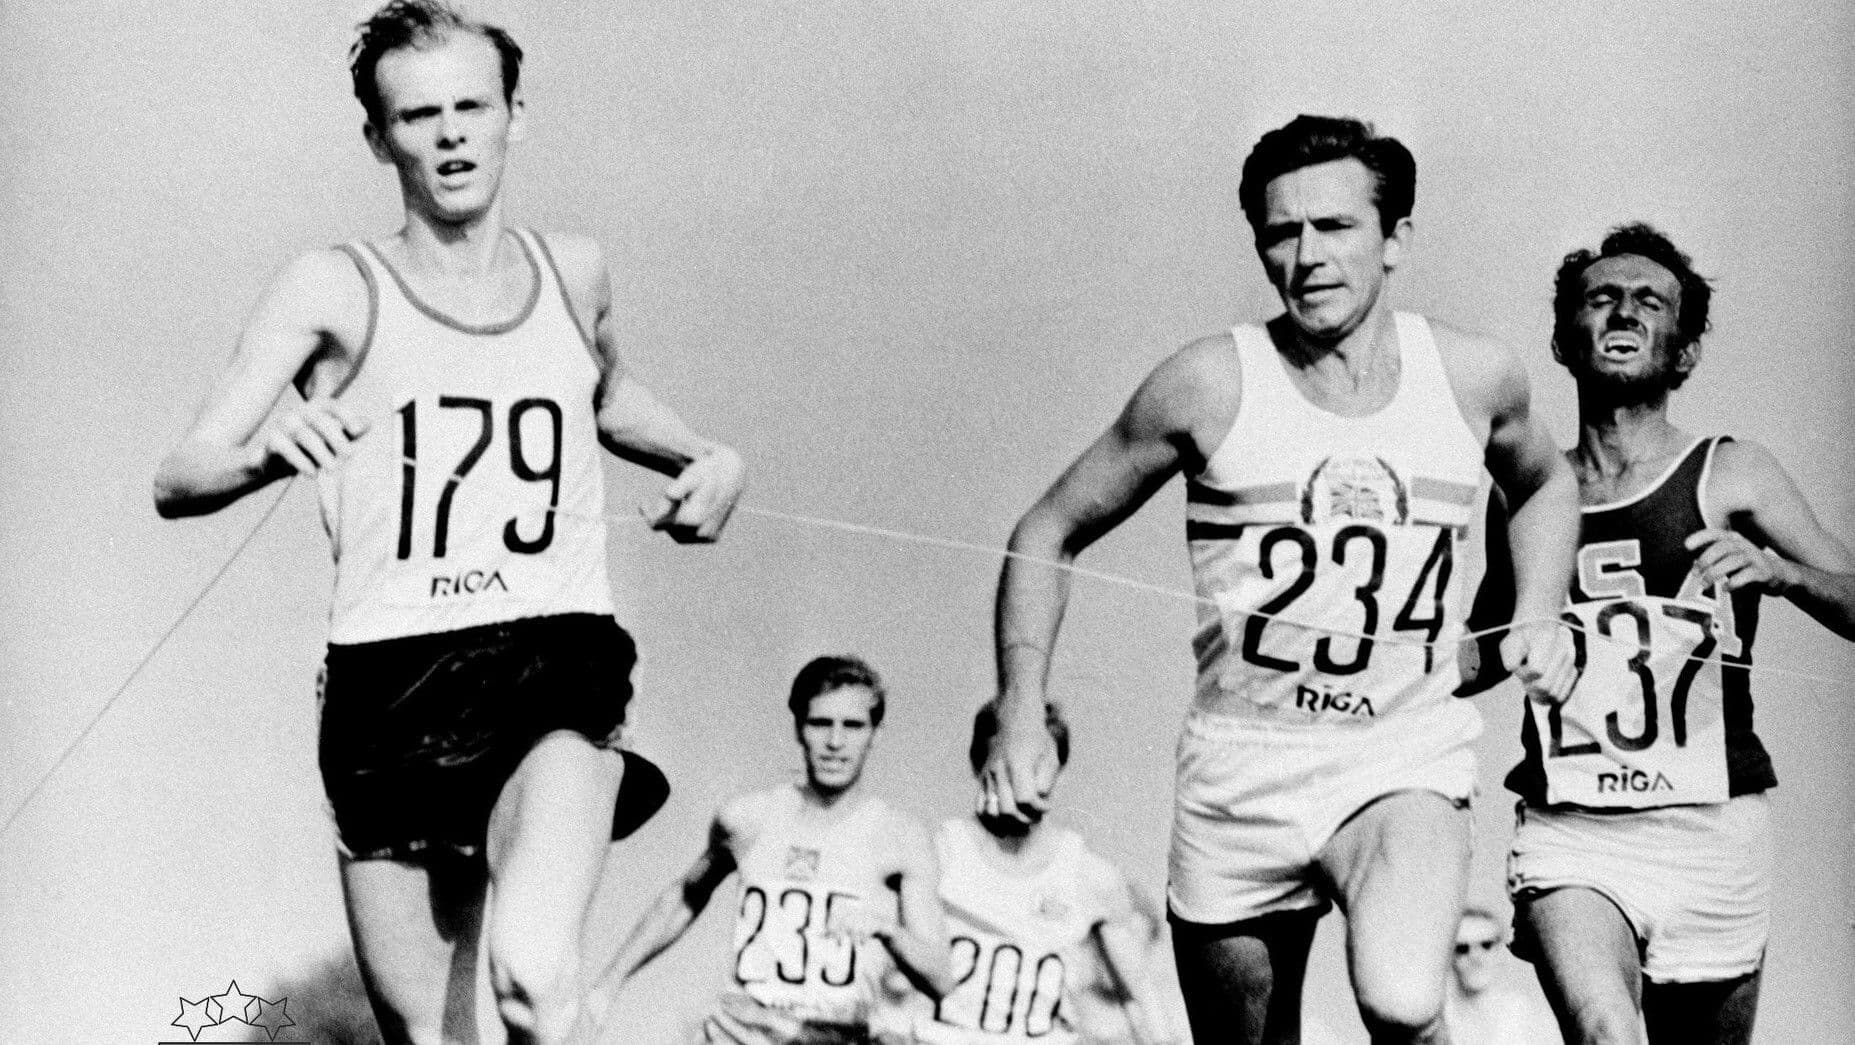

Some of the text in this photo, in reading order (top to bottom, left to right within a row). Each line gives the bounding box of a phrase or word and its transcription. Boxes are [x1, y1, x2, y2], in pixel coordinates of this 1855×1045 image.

[396, 395, 562, 560] 179
[1242, 525, 1453, 676] 234
[1549, 600, 1717, 758] 237
[735, 886, 860, 986] 235
[933, 936, 1065, 1038] 200
